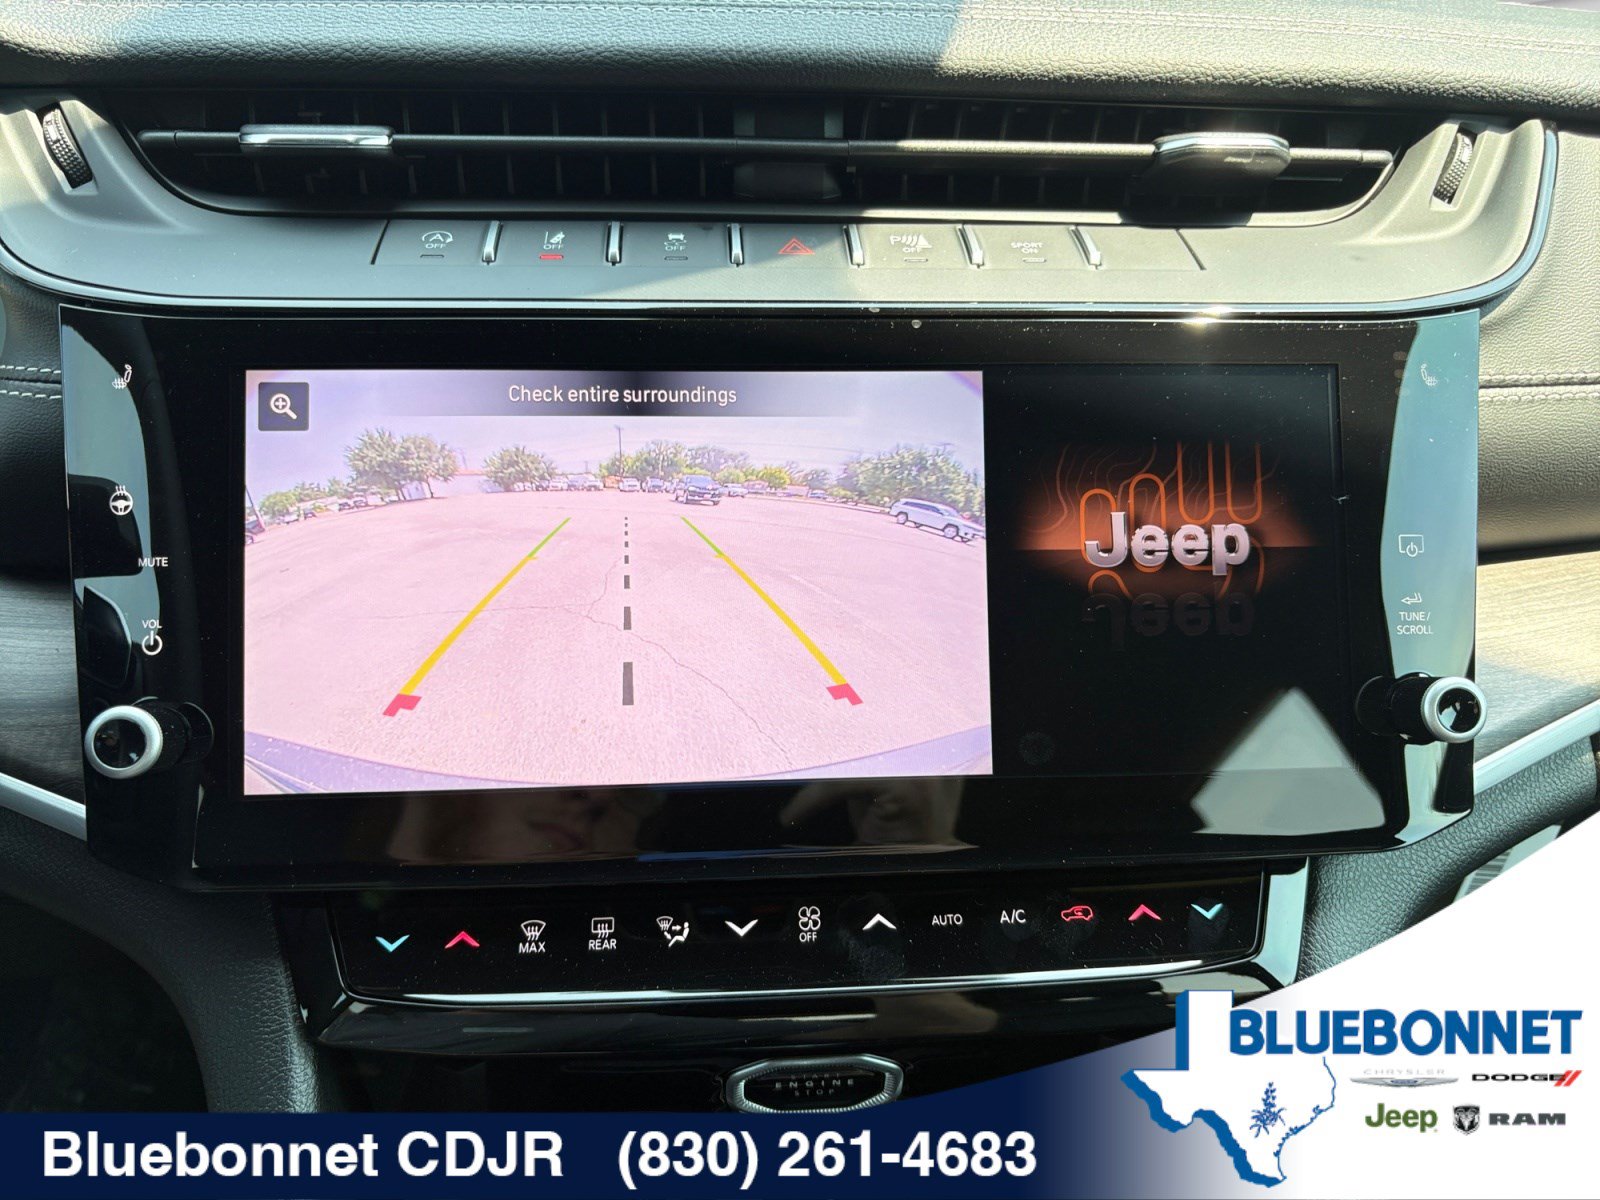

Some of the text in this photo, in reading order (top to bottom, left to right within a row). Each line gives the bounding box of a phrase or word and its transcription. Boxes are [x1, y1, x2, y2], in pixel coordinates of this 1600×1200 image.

[425, 242, 448, 250] OFF
[543, 242, 565, 250] OFF
[664, 244, 687, 252] OFF
[1011, 241, 1044, 249] SPORT
[508, 385, 738, 407] Check entire surroundings
[1084, 511, 1251, 576] Jeep
[138, 556, 169, 568] MUTE
[142, 619, 163, 629] VOL
[1396, 624, 1434, 635] SCROLL
[931, 913, 964, 926] AUTO
[1000, 908, 1027, 925] A/C
[799, 931, 818, 943] OFF
[518, 940, 546, 954] MAX
[588, 938, 617, 951] REAR
[775, 1078, 855, 1090] ENGINE
